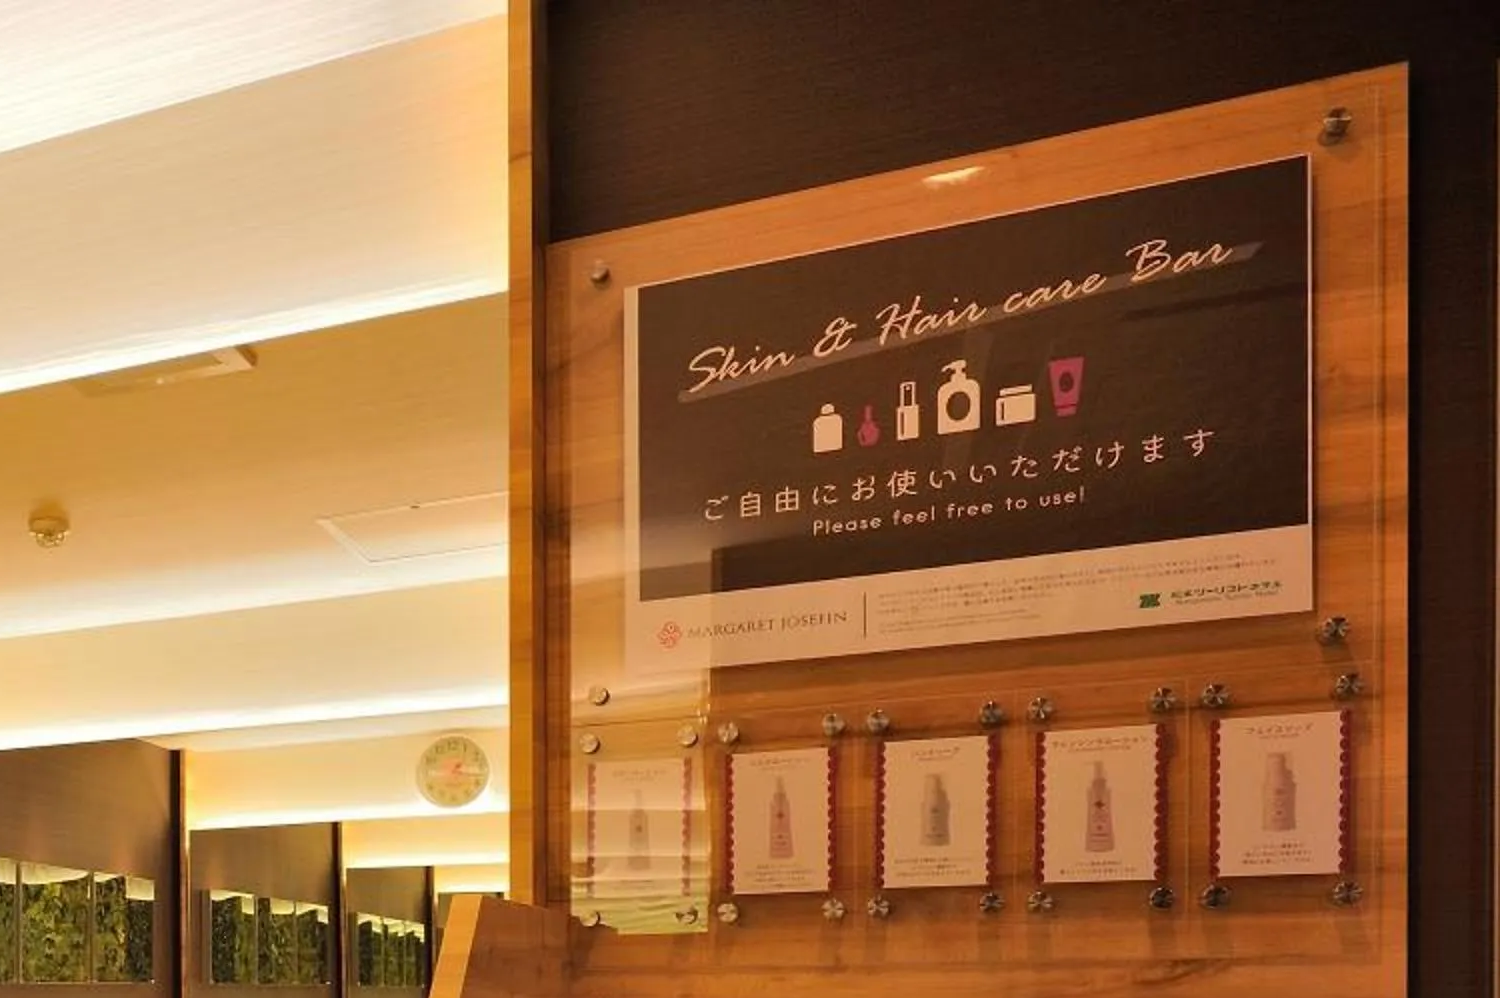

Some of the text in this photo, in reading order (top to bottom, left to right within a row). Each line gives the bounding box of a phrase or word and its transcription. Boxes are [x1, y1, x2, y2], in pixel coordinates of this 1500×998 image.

[687, 237, 1236, 394] Skin & Hair care Bar
[703, 427, 1216, 522] ご自由にお使いいただけます
[812, 485, 1086, 537] Please feel free to use!
[687, 618, 775, 639] MARGARET
